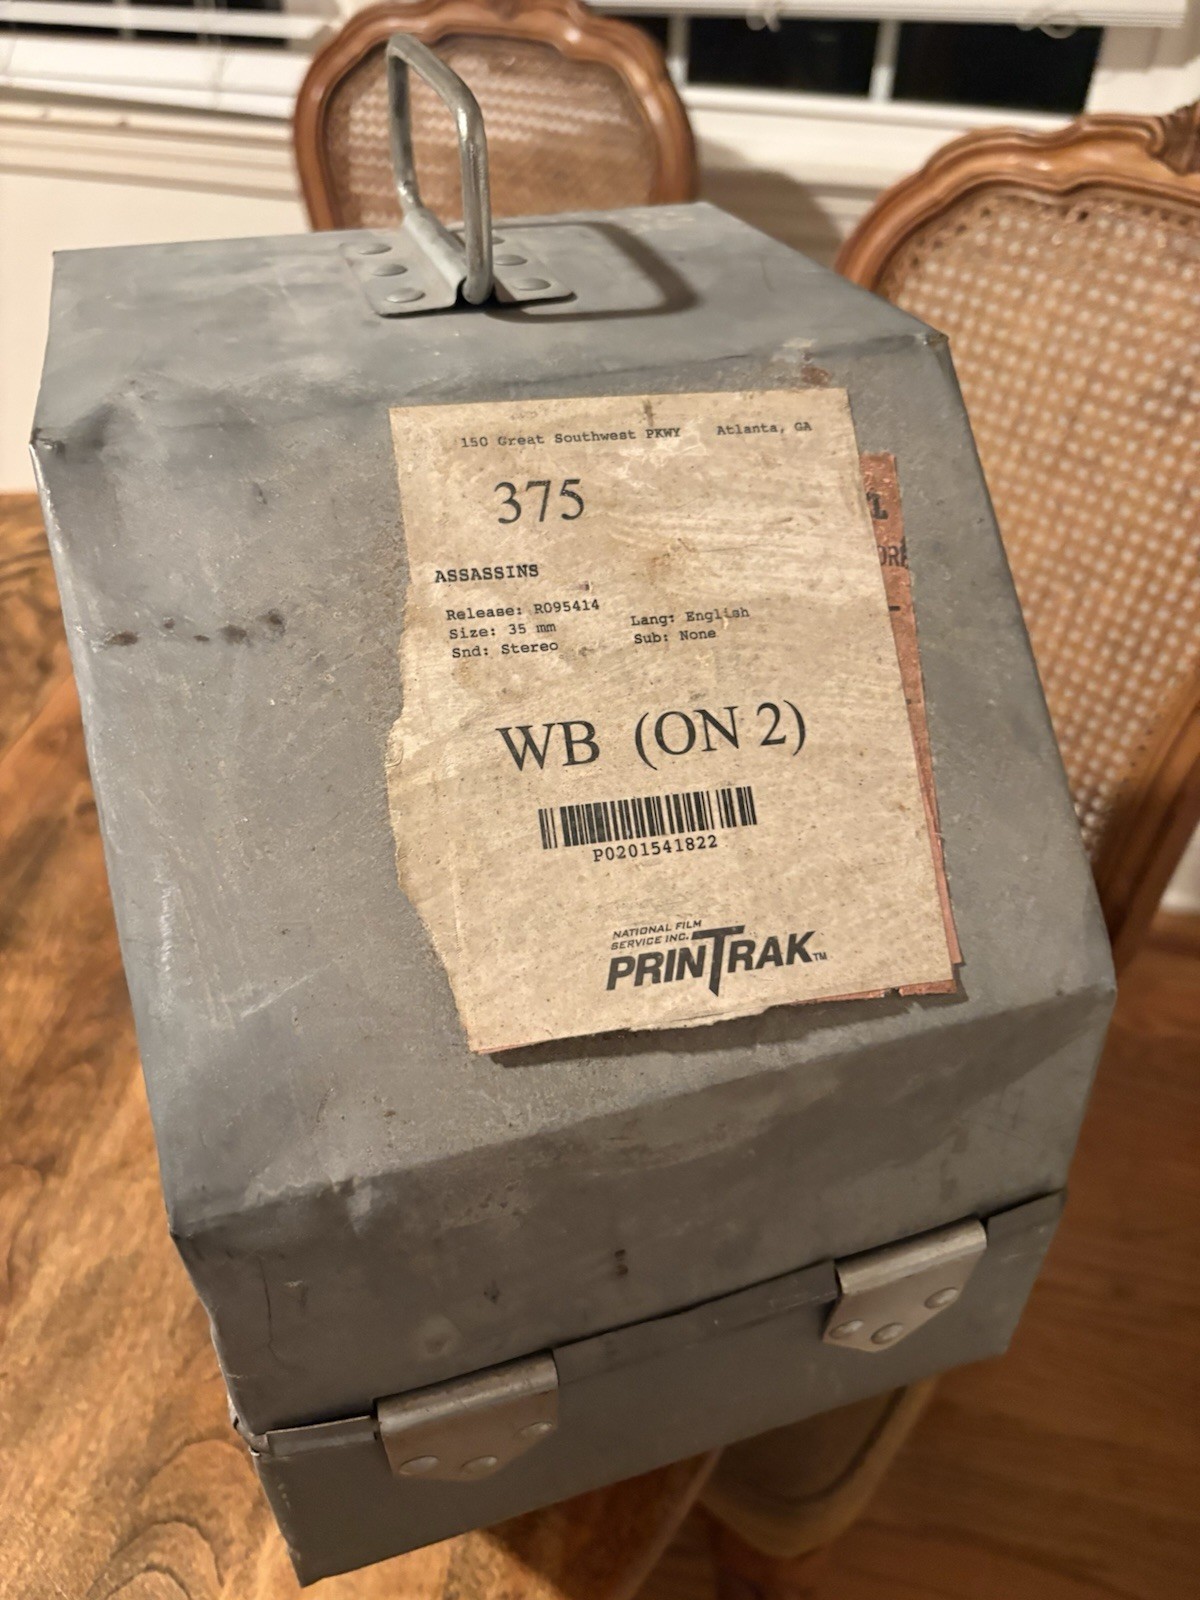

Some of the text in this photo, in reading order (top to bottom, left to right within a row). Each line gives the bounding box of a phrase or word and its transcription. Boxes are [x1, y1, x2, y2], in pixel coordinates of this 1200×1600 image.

[461, 427, 681, 448] 150 Great Southwest PKWY
[716, 421, 812, 436] Atlanta, GA
[494, 478, 585, 524] 375
[434, 564, 539, 583] ASSASSINS
[446, 606, 523, 621] Release:
[631, 607, 750, 627] Lang: English
[449, 622, 557, 640] Size: 35 mm
[633, 628, 717, 645] Sub: None
[452, 640, 559, 659] Snd: Stereo
[495, 699, 806, 772] WB (ON 2)
[593, 834, 718, 862] P0201541822
[612, 920, 702, 940] NATIONAL FILM
[610, 933, 690, 951] SERVICE INC.
[606, 925, 816, 997] PRINTRAK
